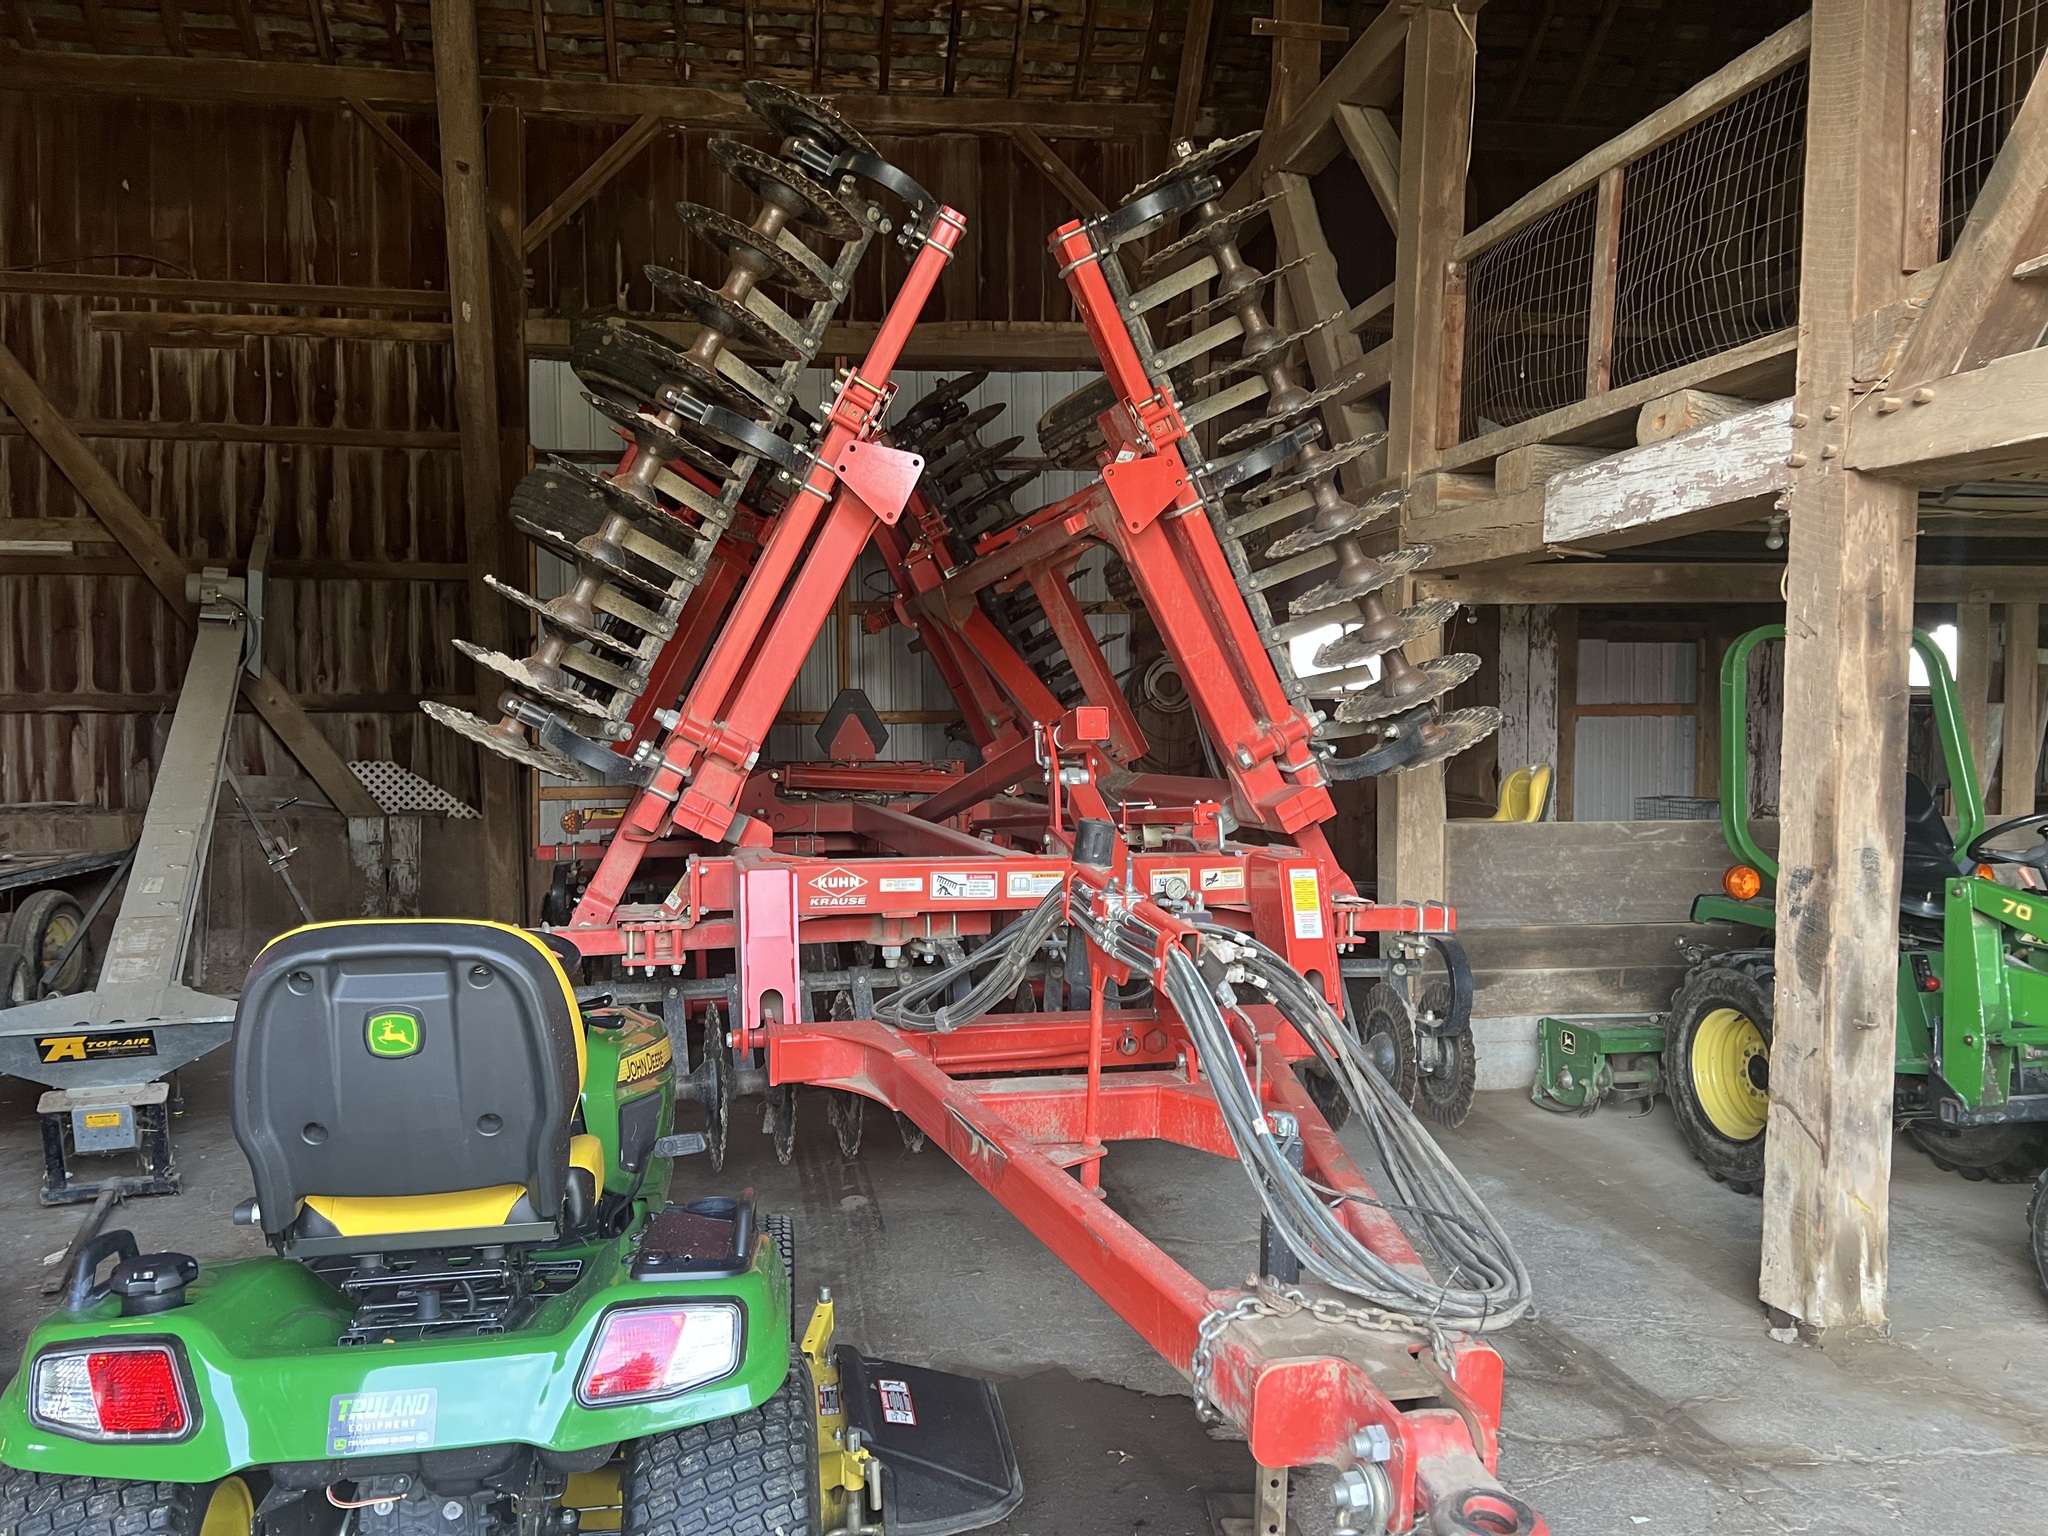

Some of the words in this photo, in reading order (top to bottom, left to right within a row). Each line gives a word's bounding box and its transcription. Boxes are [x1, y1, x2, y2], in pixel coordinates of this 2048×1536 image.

[817, 877, 860, 889] KUHN
[810, 897, 866, 906] KRAUSE
[2002, 898, 2033, 921] 70
[86, 1037, 150, 1049] TOP-AIR
[627, 1059, 647, 1079] JOHN
[646, 1051, 664, 1070] DEERE
[338, 1393, 430, 1421] TRULAND
[348, 1419, 416, 1433] EQUIPMENT
